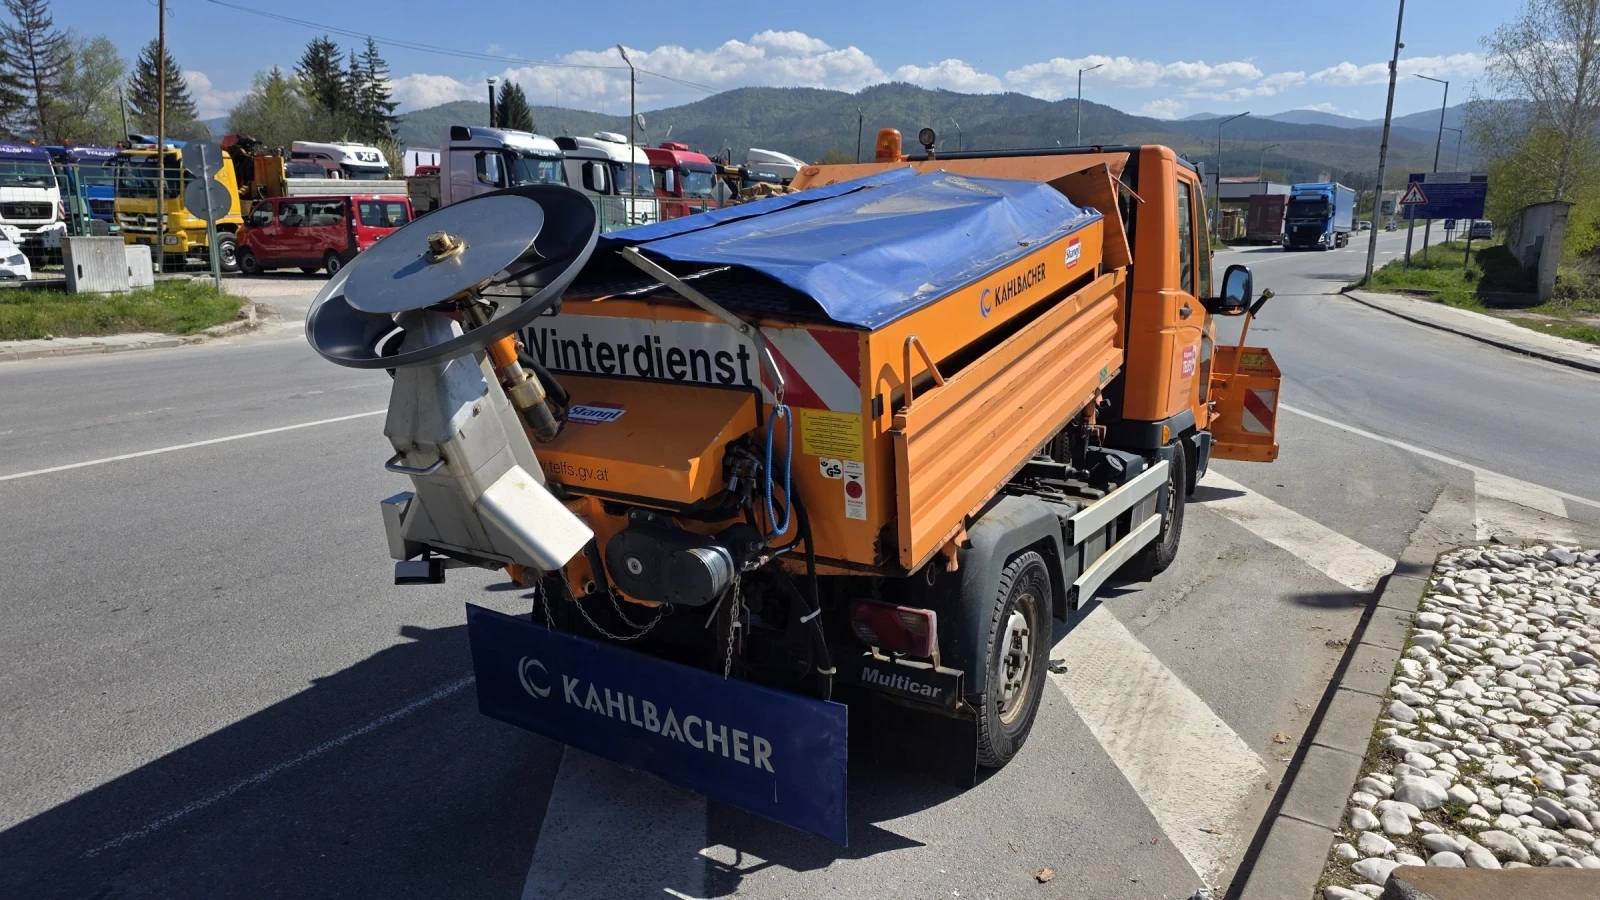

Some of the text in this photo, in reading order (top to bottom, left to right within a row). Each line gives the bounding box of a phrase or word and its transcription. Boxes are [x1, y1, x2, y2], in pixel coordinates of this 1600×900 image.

[360, 152, 376, 161] XF
[994, 263, 1046, 307] KAHLBACHER
[519, 327, 752, 386] Winterdienst
[569, 406, 622, 420] Stangl
[826, 465, 841, 477] GS
[861, 667, 942, 698] Multicar
[562, 674, 774, 773] KAHLBACHER
